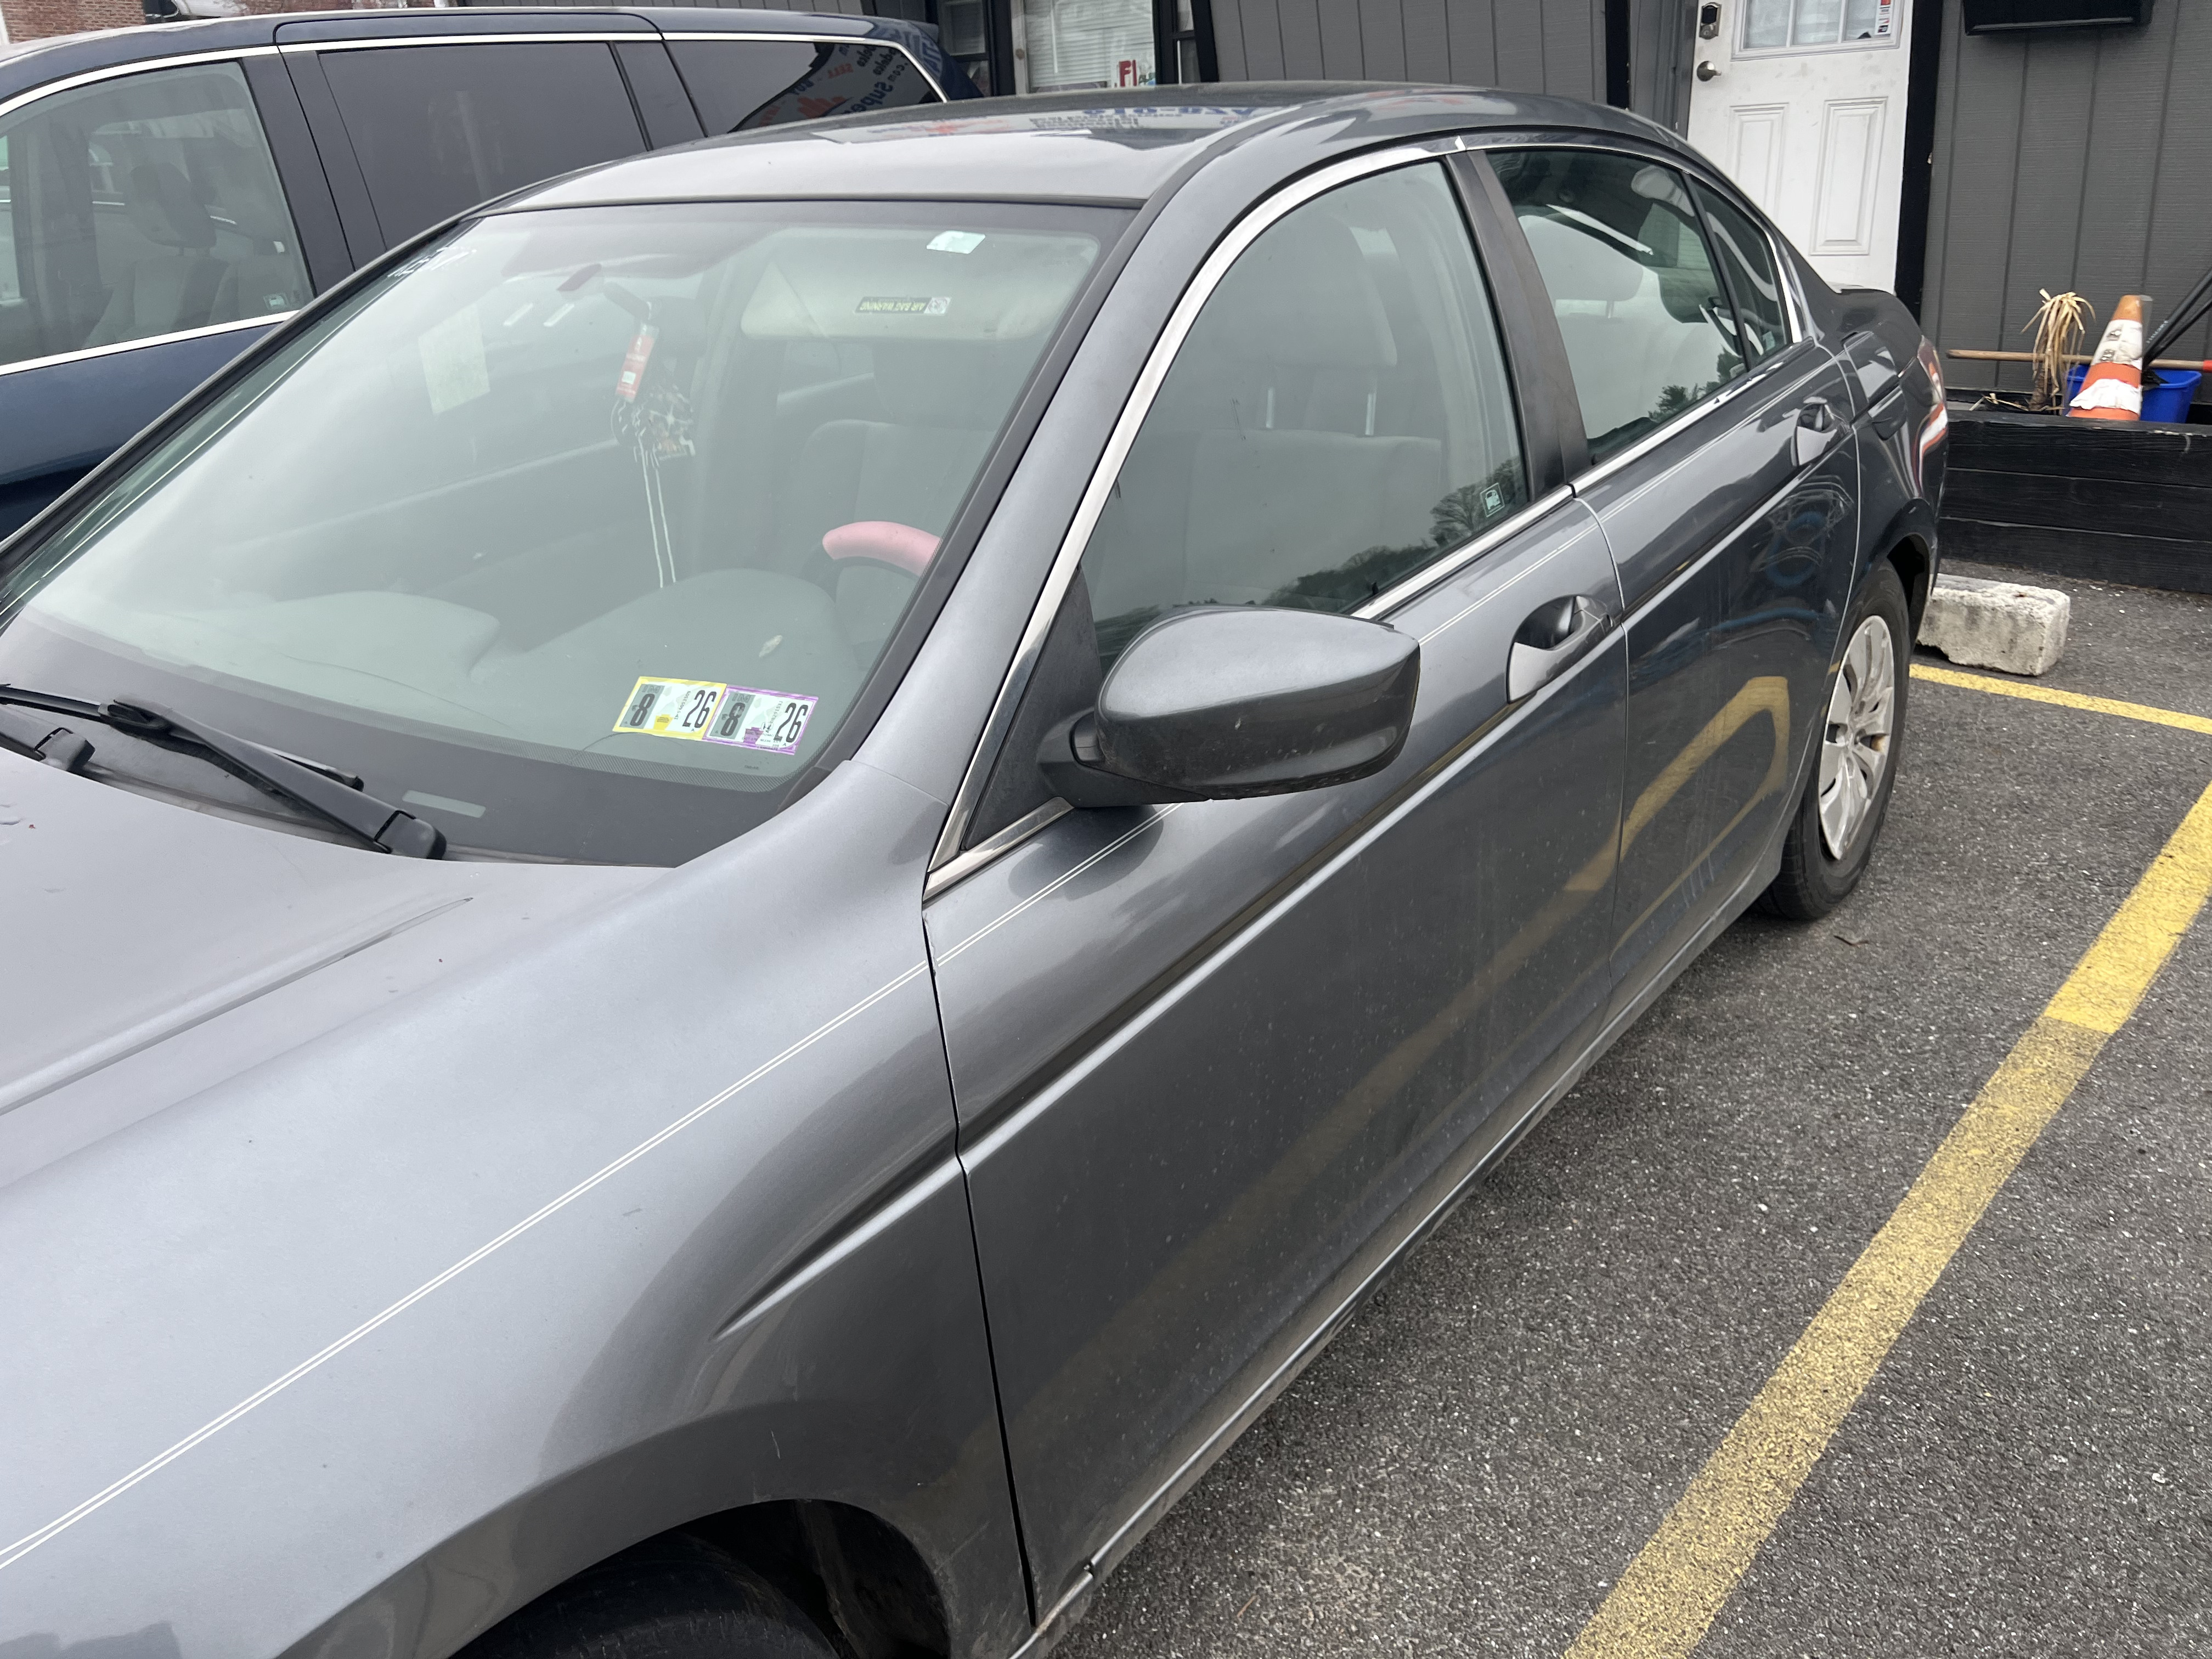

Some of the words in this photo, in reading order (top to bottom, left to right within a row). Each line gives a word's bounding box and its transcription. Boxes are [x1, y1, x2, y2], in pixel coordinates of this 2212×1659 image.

[859, 301, 895, 311] WARNING
[895, 302, 912, 312] BAG
[911, 302, 926, 311] AIR
[629, 693, 655, 726] 8
[682, 690, 716, 729] 26
[720, 702, 746, 736] 8
[774, 697, 809, 743] 26
